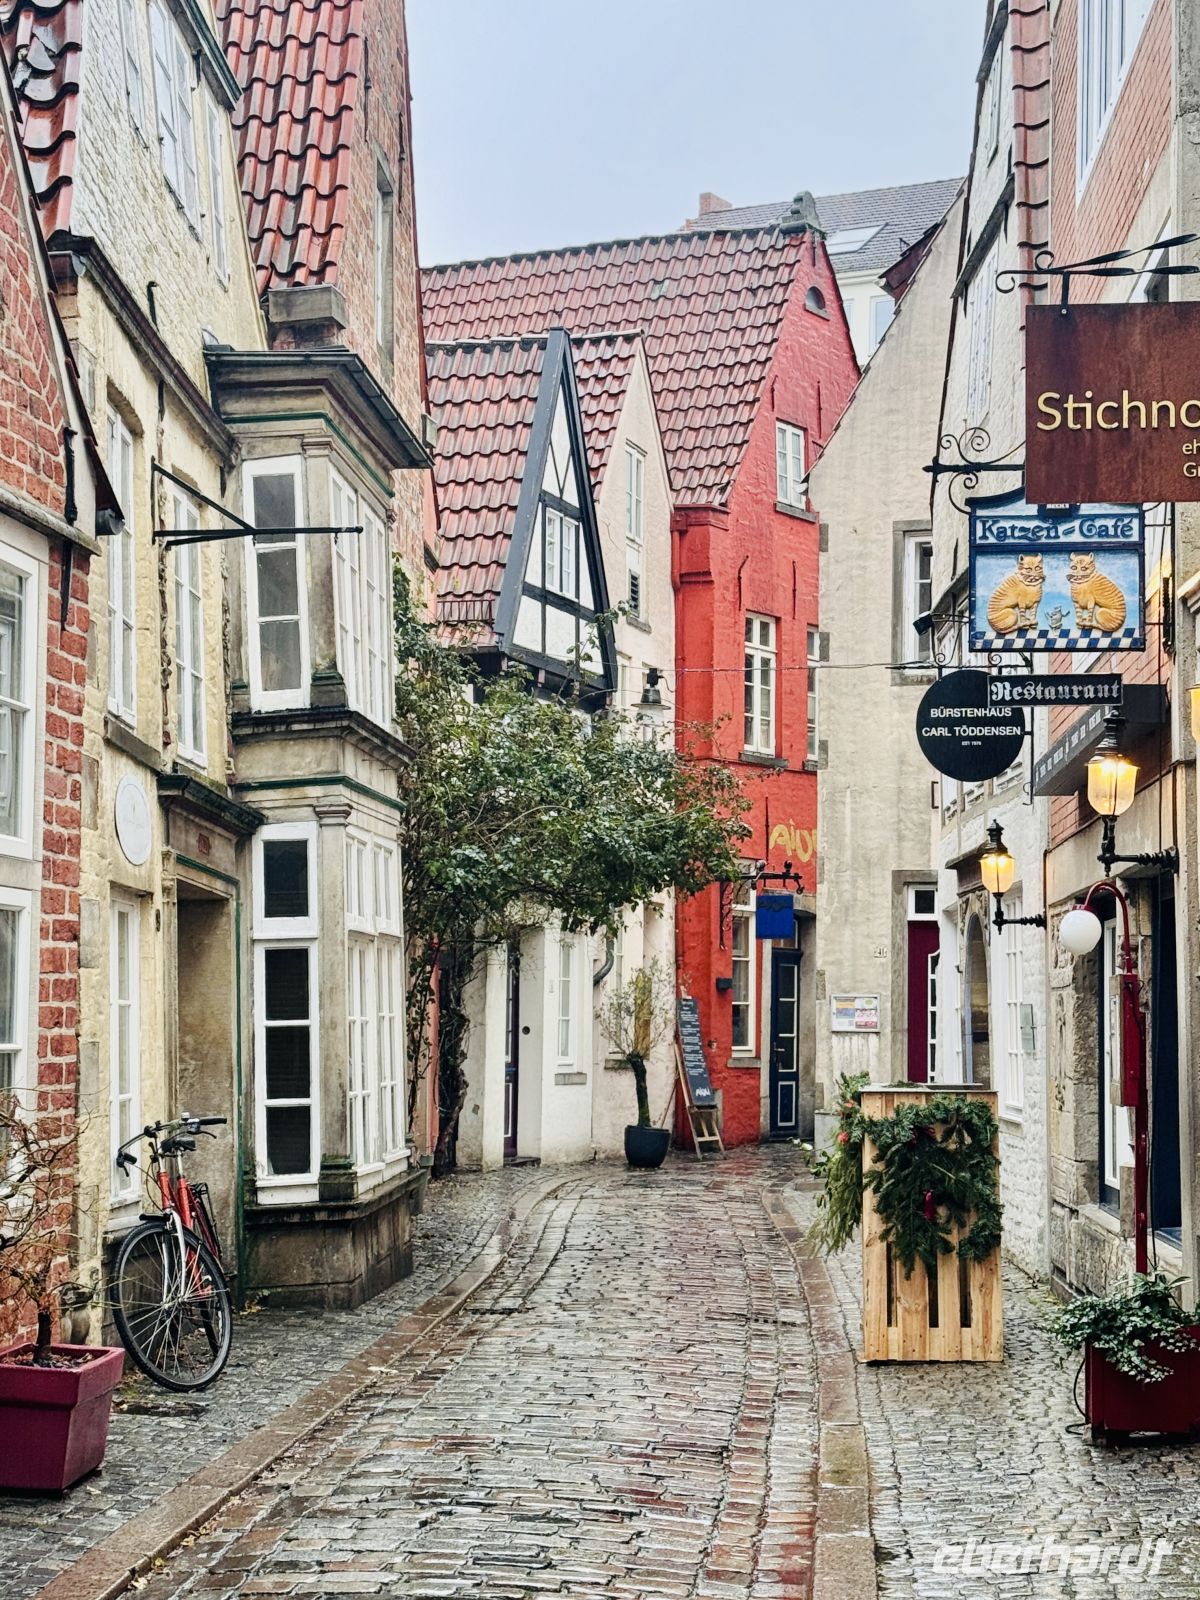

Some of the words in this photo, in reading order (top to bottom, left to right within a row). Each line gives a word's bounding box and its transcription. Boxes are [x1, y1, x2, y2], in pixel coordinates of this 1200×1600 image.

[990, 680, 1120, 701] Restaurant
[930, 706, 1012, 718] BÜRSTENHAUS
[922, 727, 952, 737] CARL
[954, 725, 1021, 737] TÖDDENSEN
